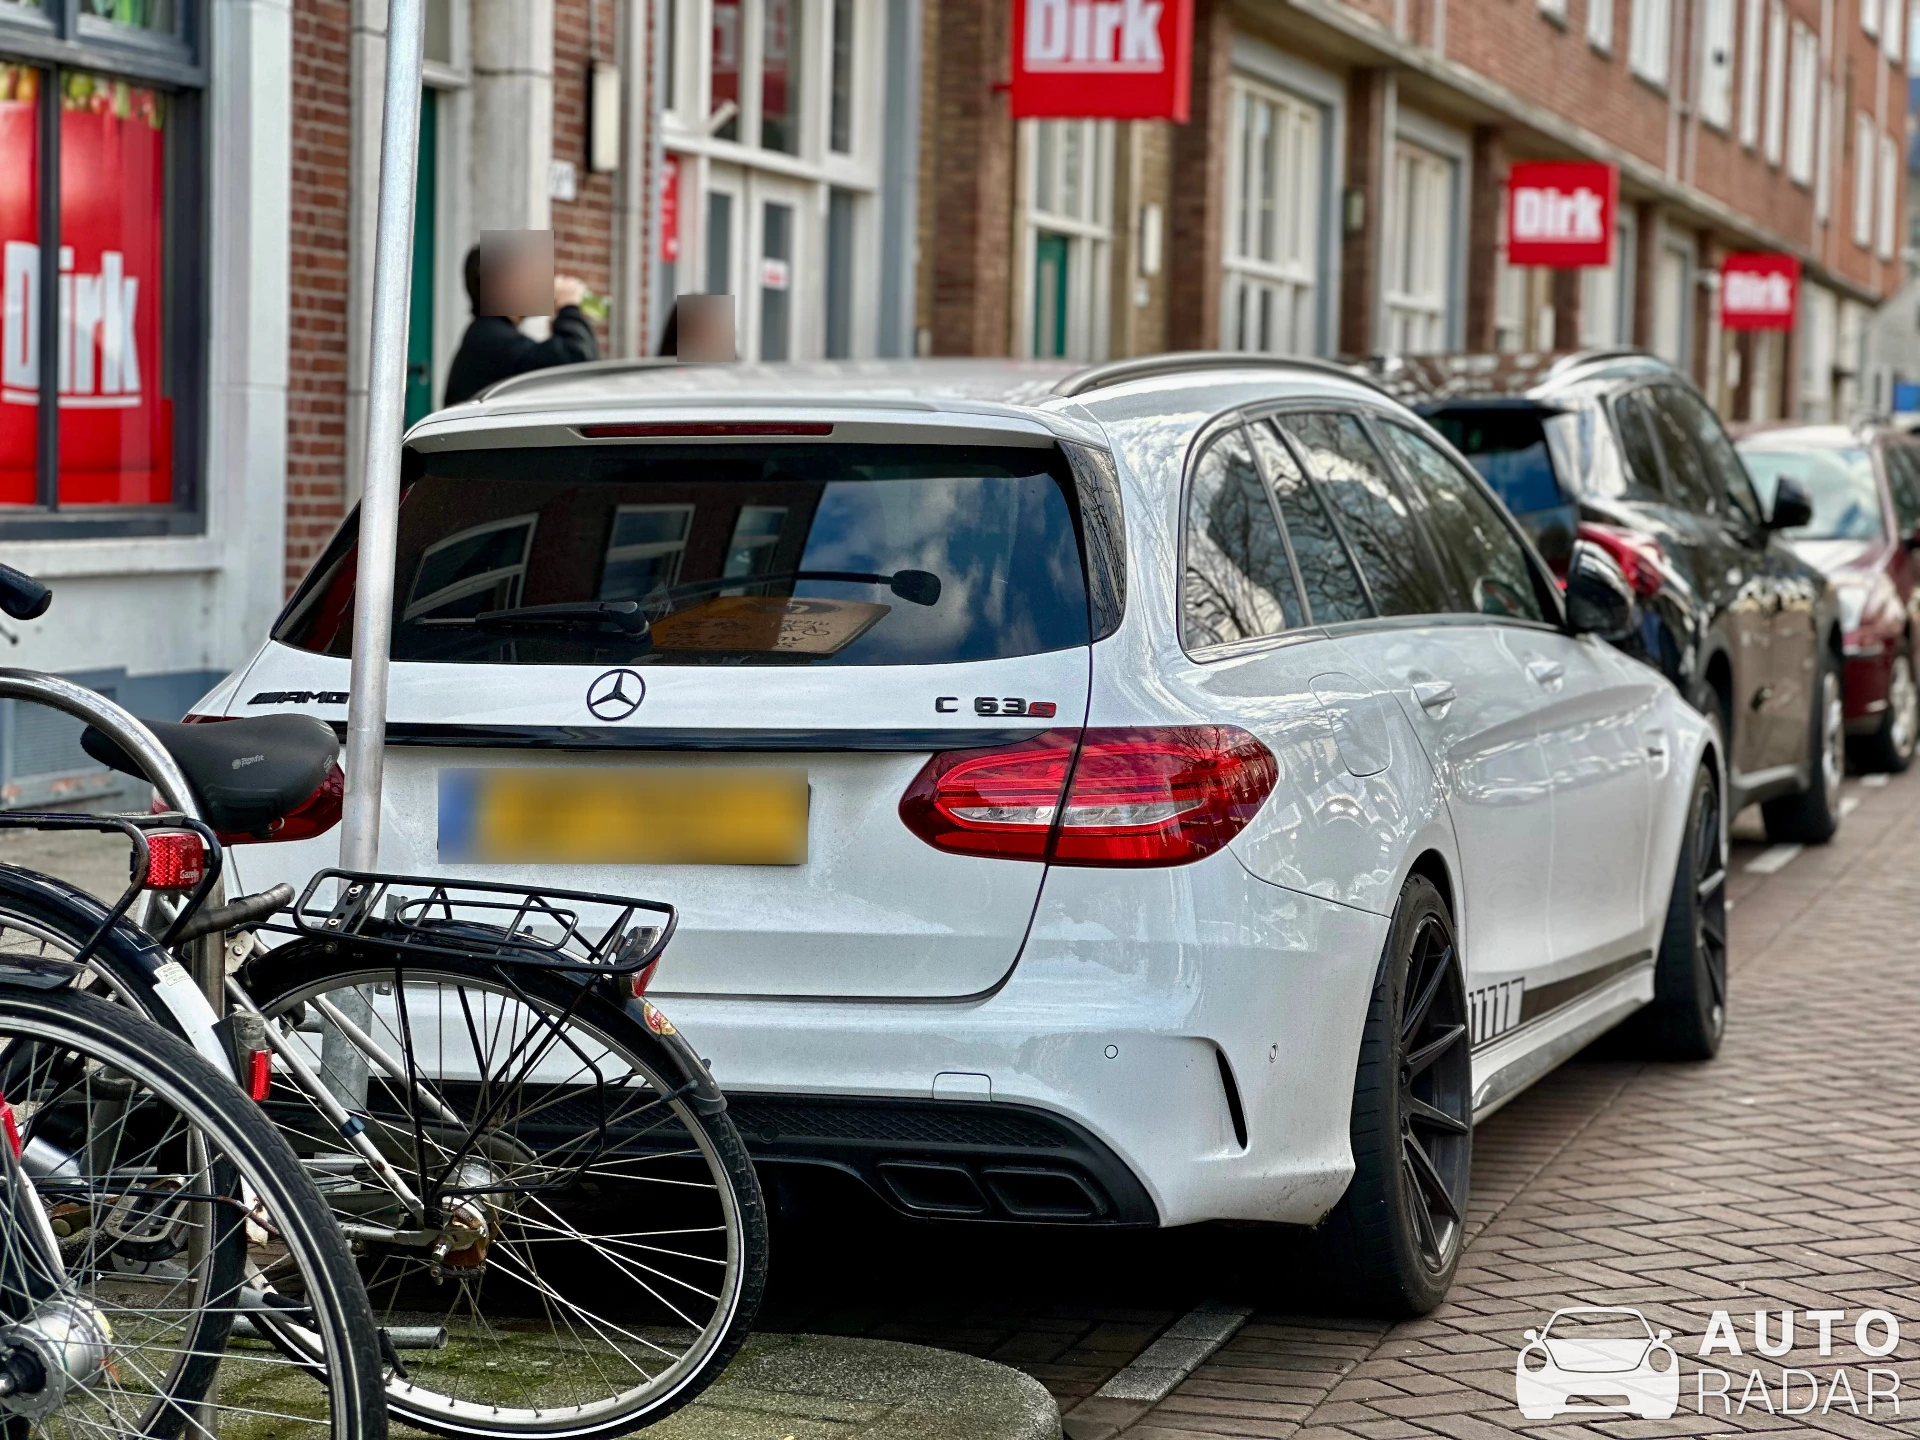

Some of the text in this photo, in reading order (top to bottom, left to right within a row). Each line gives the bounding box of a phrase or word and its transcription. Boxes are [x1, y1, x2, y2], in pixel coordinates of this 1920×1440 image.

[1024, 0, 1163, 66] Dirk
[1513, 187, 1603, 238] Dirk
[4, 240, 140, 393] Dirk
[1725, 270, 1790, 312] Dirk
[935, 696, 958, 713] C
